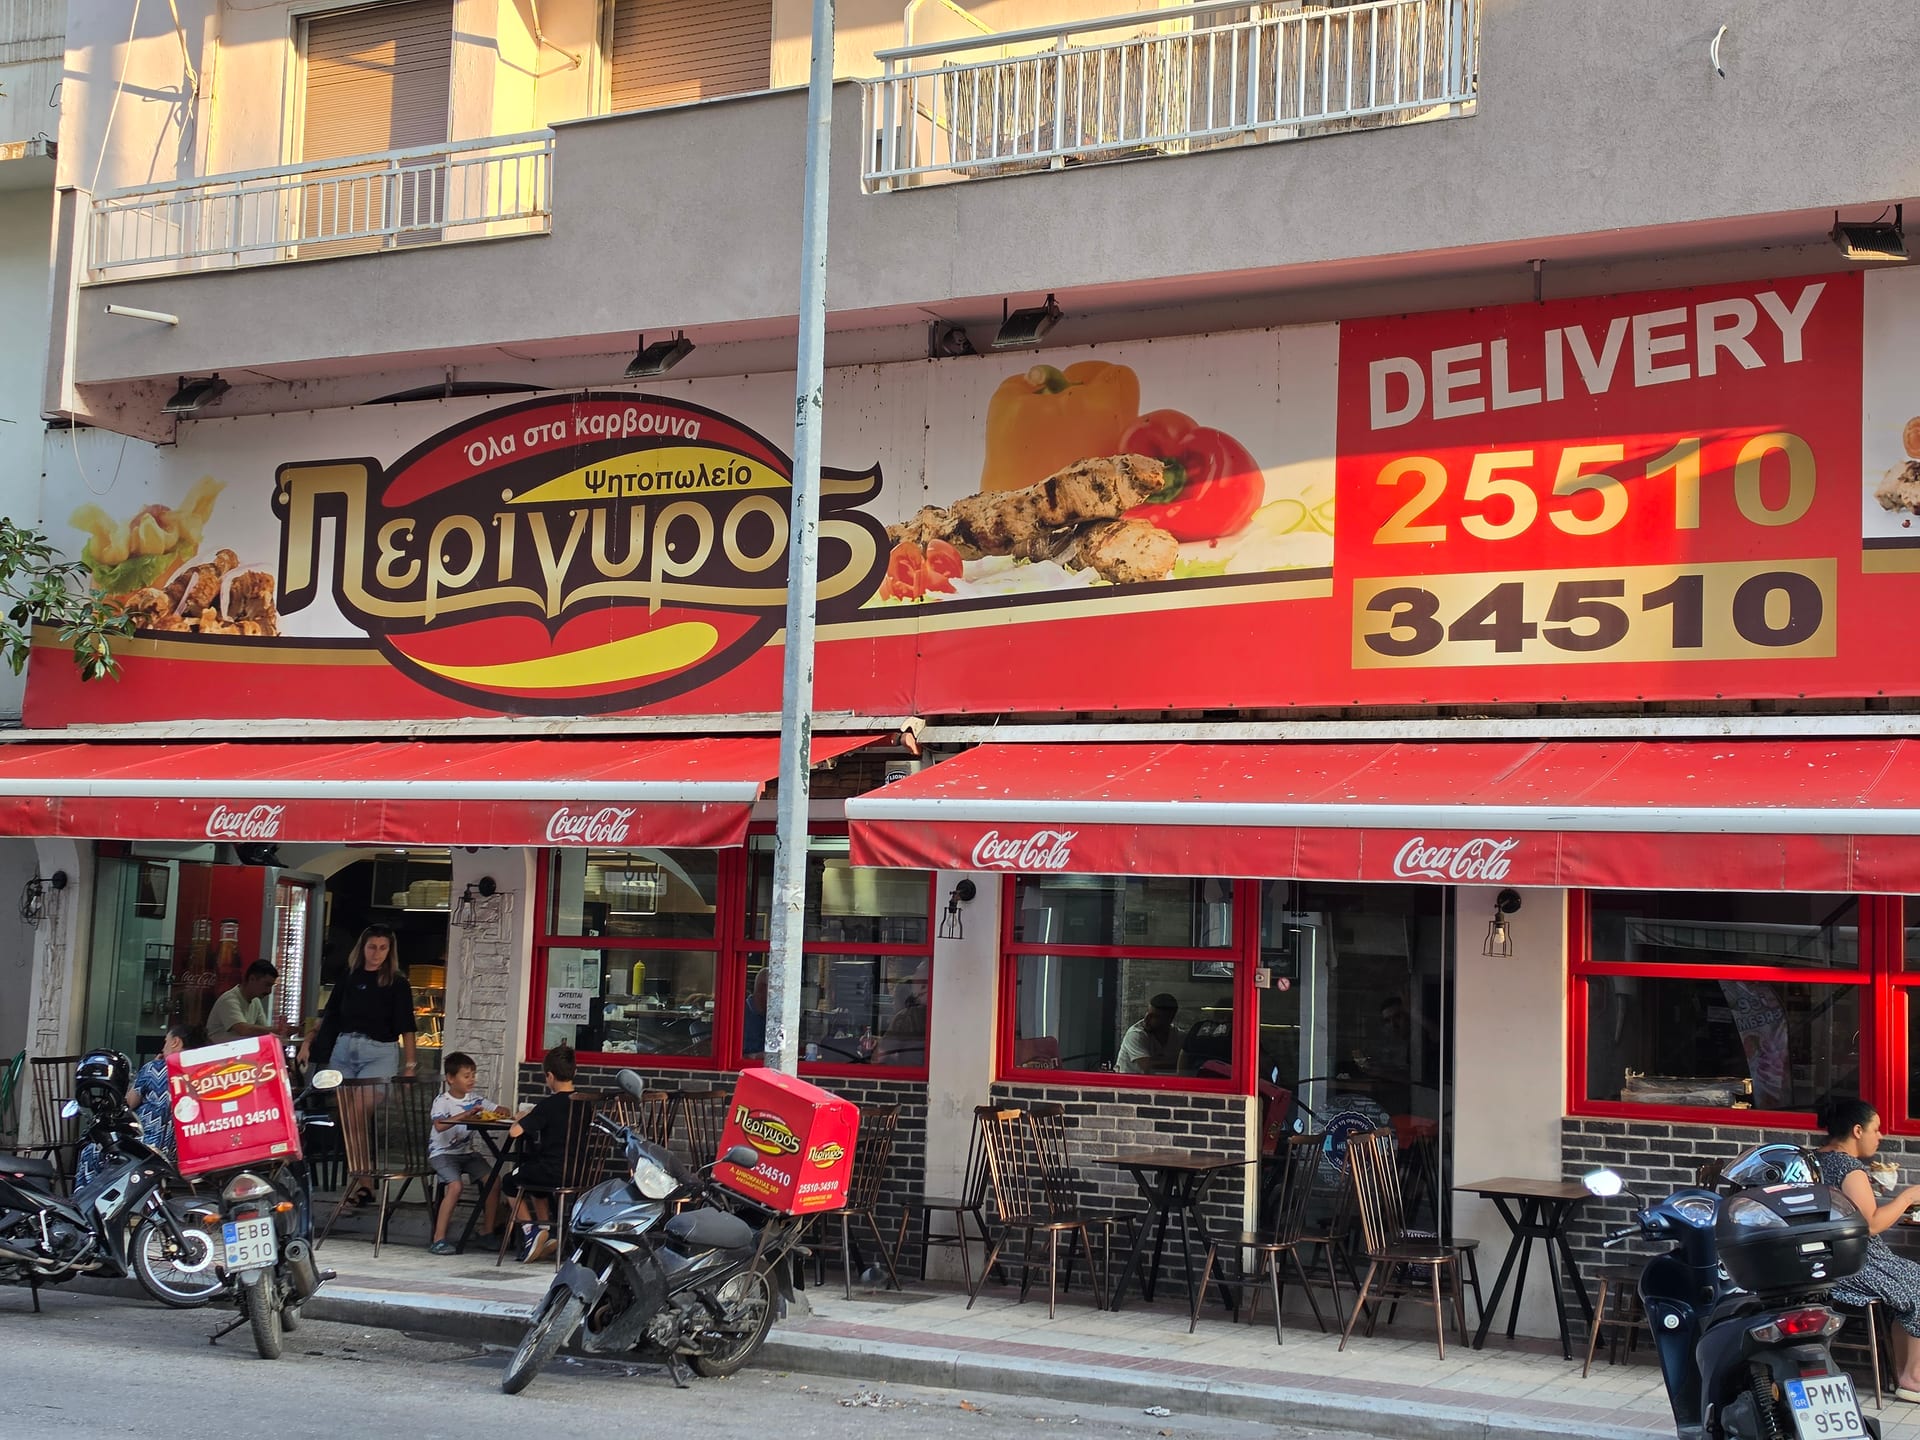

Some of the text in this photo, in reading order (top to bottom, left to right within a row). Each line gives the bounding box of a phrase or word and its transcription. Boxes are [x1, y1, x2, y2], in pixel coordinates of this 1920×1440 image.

[1369, 282, 1827, 430] DELIVERY
[464, 407, 701, 466] Όλα στα καρβουνα
[584, 459, 752, 497] Ψητοπωλείο
[1372, 432, 1817, 545] 25510
[1364, 571, 1824, 657] 34510
[205, 805, 286, 838] Coca-Cola
[546, 807, 637, 842] Coca-Cola
[972, 830, 1079, 868] Coca-Cola
[1394, 837, 1520, 880] Coca-Cola
[244, 1107, 280, 1125] 34510
[237, 1222, 270, 1241] EBB
[239, 1242, 272, 1261] 510
[1794, 1398, 1807, 1407] GR
[1805, 1382, 1851, 1406] PMM
[1815, 1411, 1859, 1433] 956
